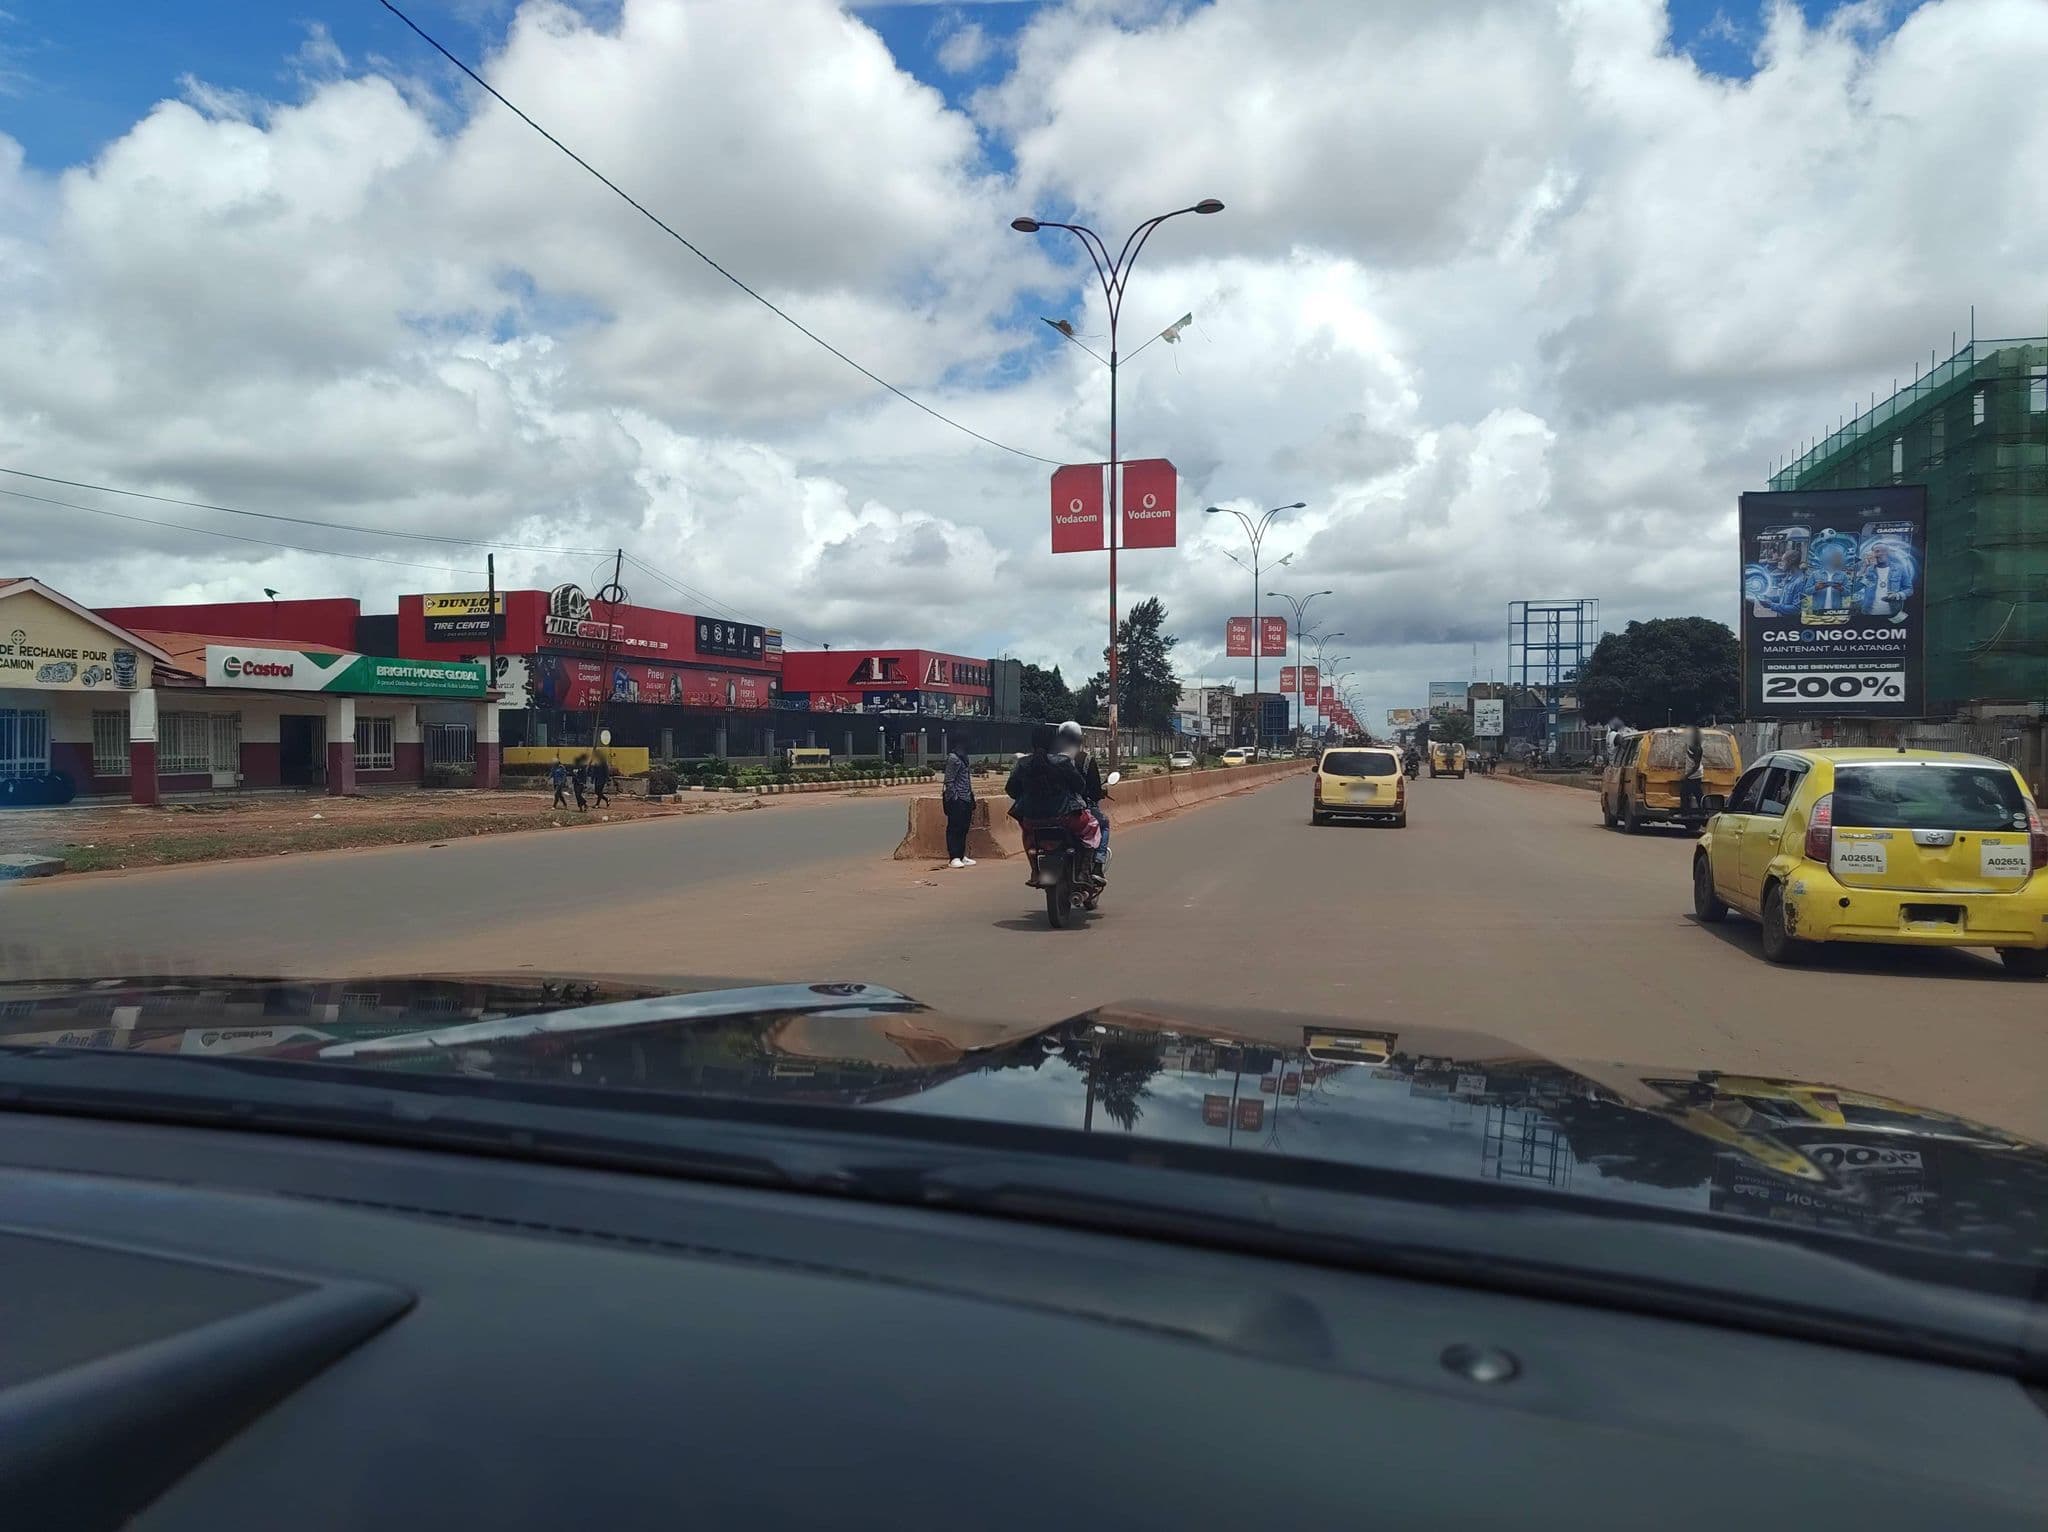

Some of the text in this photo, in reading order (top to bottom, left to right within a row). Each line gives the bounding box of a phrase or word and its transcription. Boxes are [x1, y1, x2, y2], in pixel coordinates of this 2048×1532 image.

[1056, 514, 1097, 524] Vodacom
[1128, 509, 1171, 520] Vodacom
[437, 597, 500, 608] DUNLOP
[433, 622, 454, 630] TIRE
[550, 619, 624, 641] TIRE CENTER
[1762, 629, 1906, 642] CASONGO.COM
[0, 644, 107, 661] DE RECHANGE POUR
[1763, 645, 1829, 653] MAINTENANT
[242, 660, 294, 677] Castrol
[376, 665, 479, 681] BRIGHT HOUSE GLOBAL
[647, 668, 665, 679] Pneu
[1766, 676, 1900, 698] 200%
[1840, 854, 1882, 862] A0265/L
[1988, 858, 2027, 866] A0265/L
